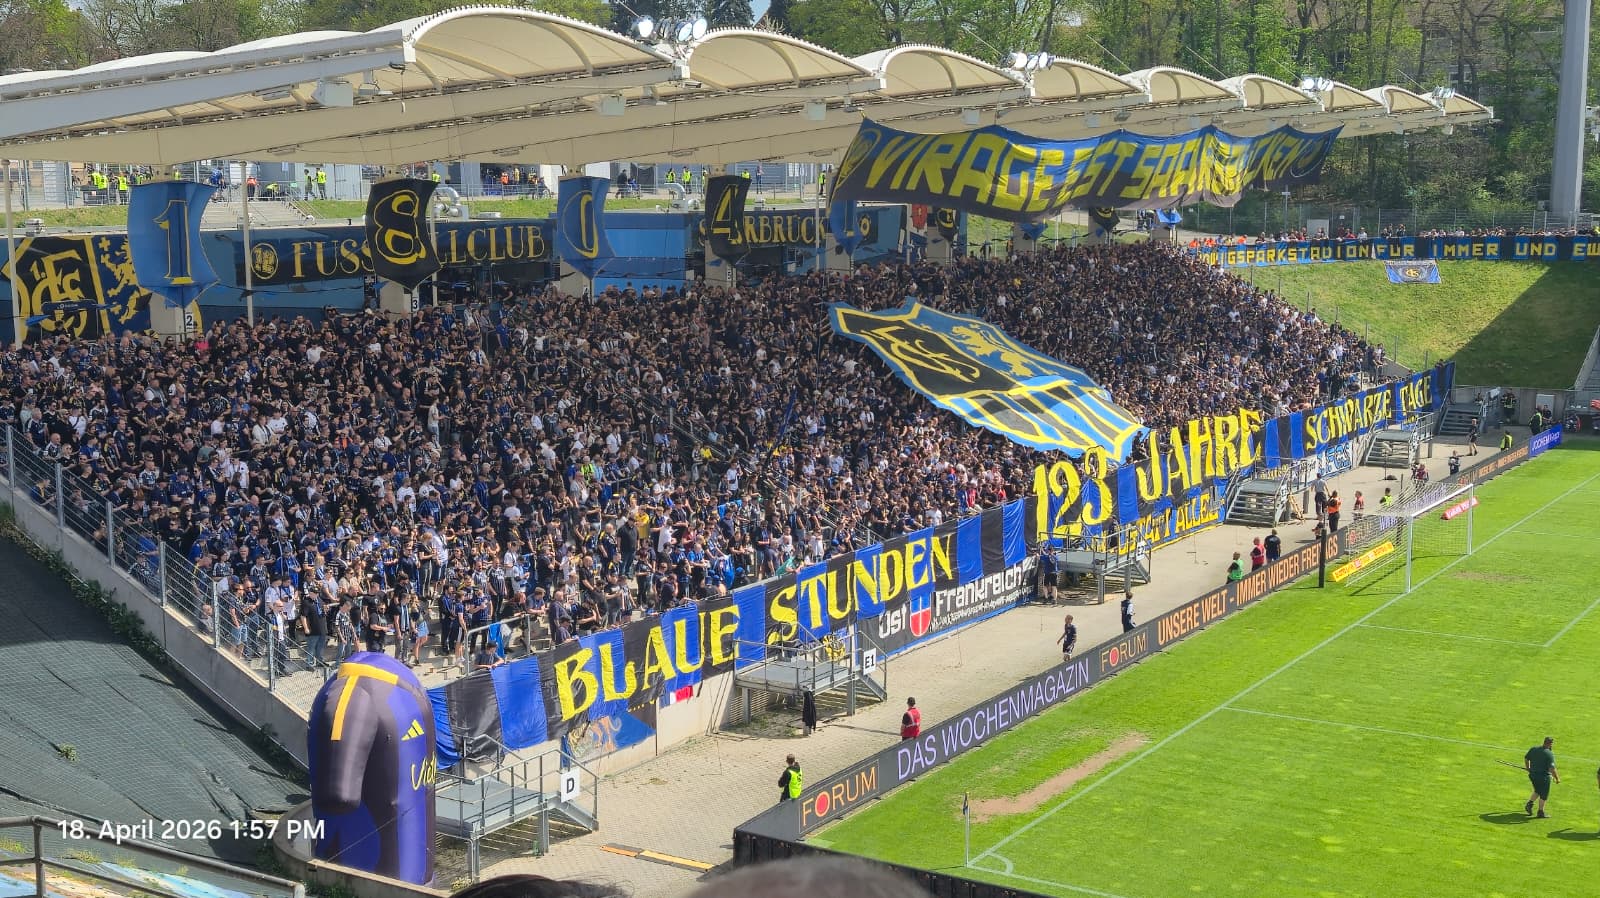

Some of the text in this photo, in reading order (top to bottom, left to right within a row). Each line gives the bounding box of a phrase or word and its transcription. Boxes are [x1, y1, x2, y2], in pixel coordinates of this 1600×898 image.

[865, 132, 1064, 212] VIRAGE
[1052, 139, 1140, 208] EST
[153, 200, 194, 284] 1
[711, 184, 742, 245] 4
[1433, 243, 1498, 257] IMMER
[1515, 243, 1557, 257] UND
[186, 315, 193, 326] 2
[1305, 375, 1433, 450] SCHWARZE TAGE
[1033, 407, 1262, 542] 123 JAHRE
[935, 564, 1023, 617] Frankreich
[1157, 602, 1200, 645] UNSERE
[1201, 589, 1229, 624] WELT
[1236, 572, 1267, 607] IMMER
[1268, 553, 1300, 588] WIEDER
[553, 604, 741, 722] BLAUE
[767, 533, 954, 646] STUNDEN
[1101, 632, 1147, 672] FORUM
[864, 654, 875, 669] E1
[897, 658, 1089, 781] DAS WOCHENMAGAZIN
[565, 777, 576, 795] D
[802, 766, 877, 827] FORUM
